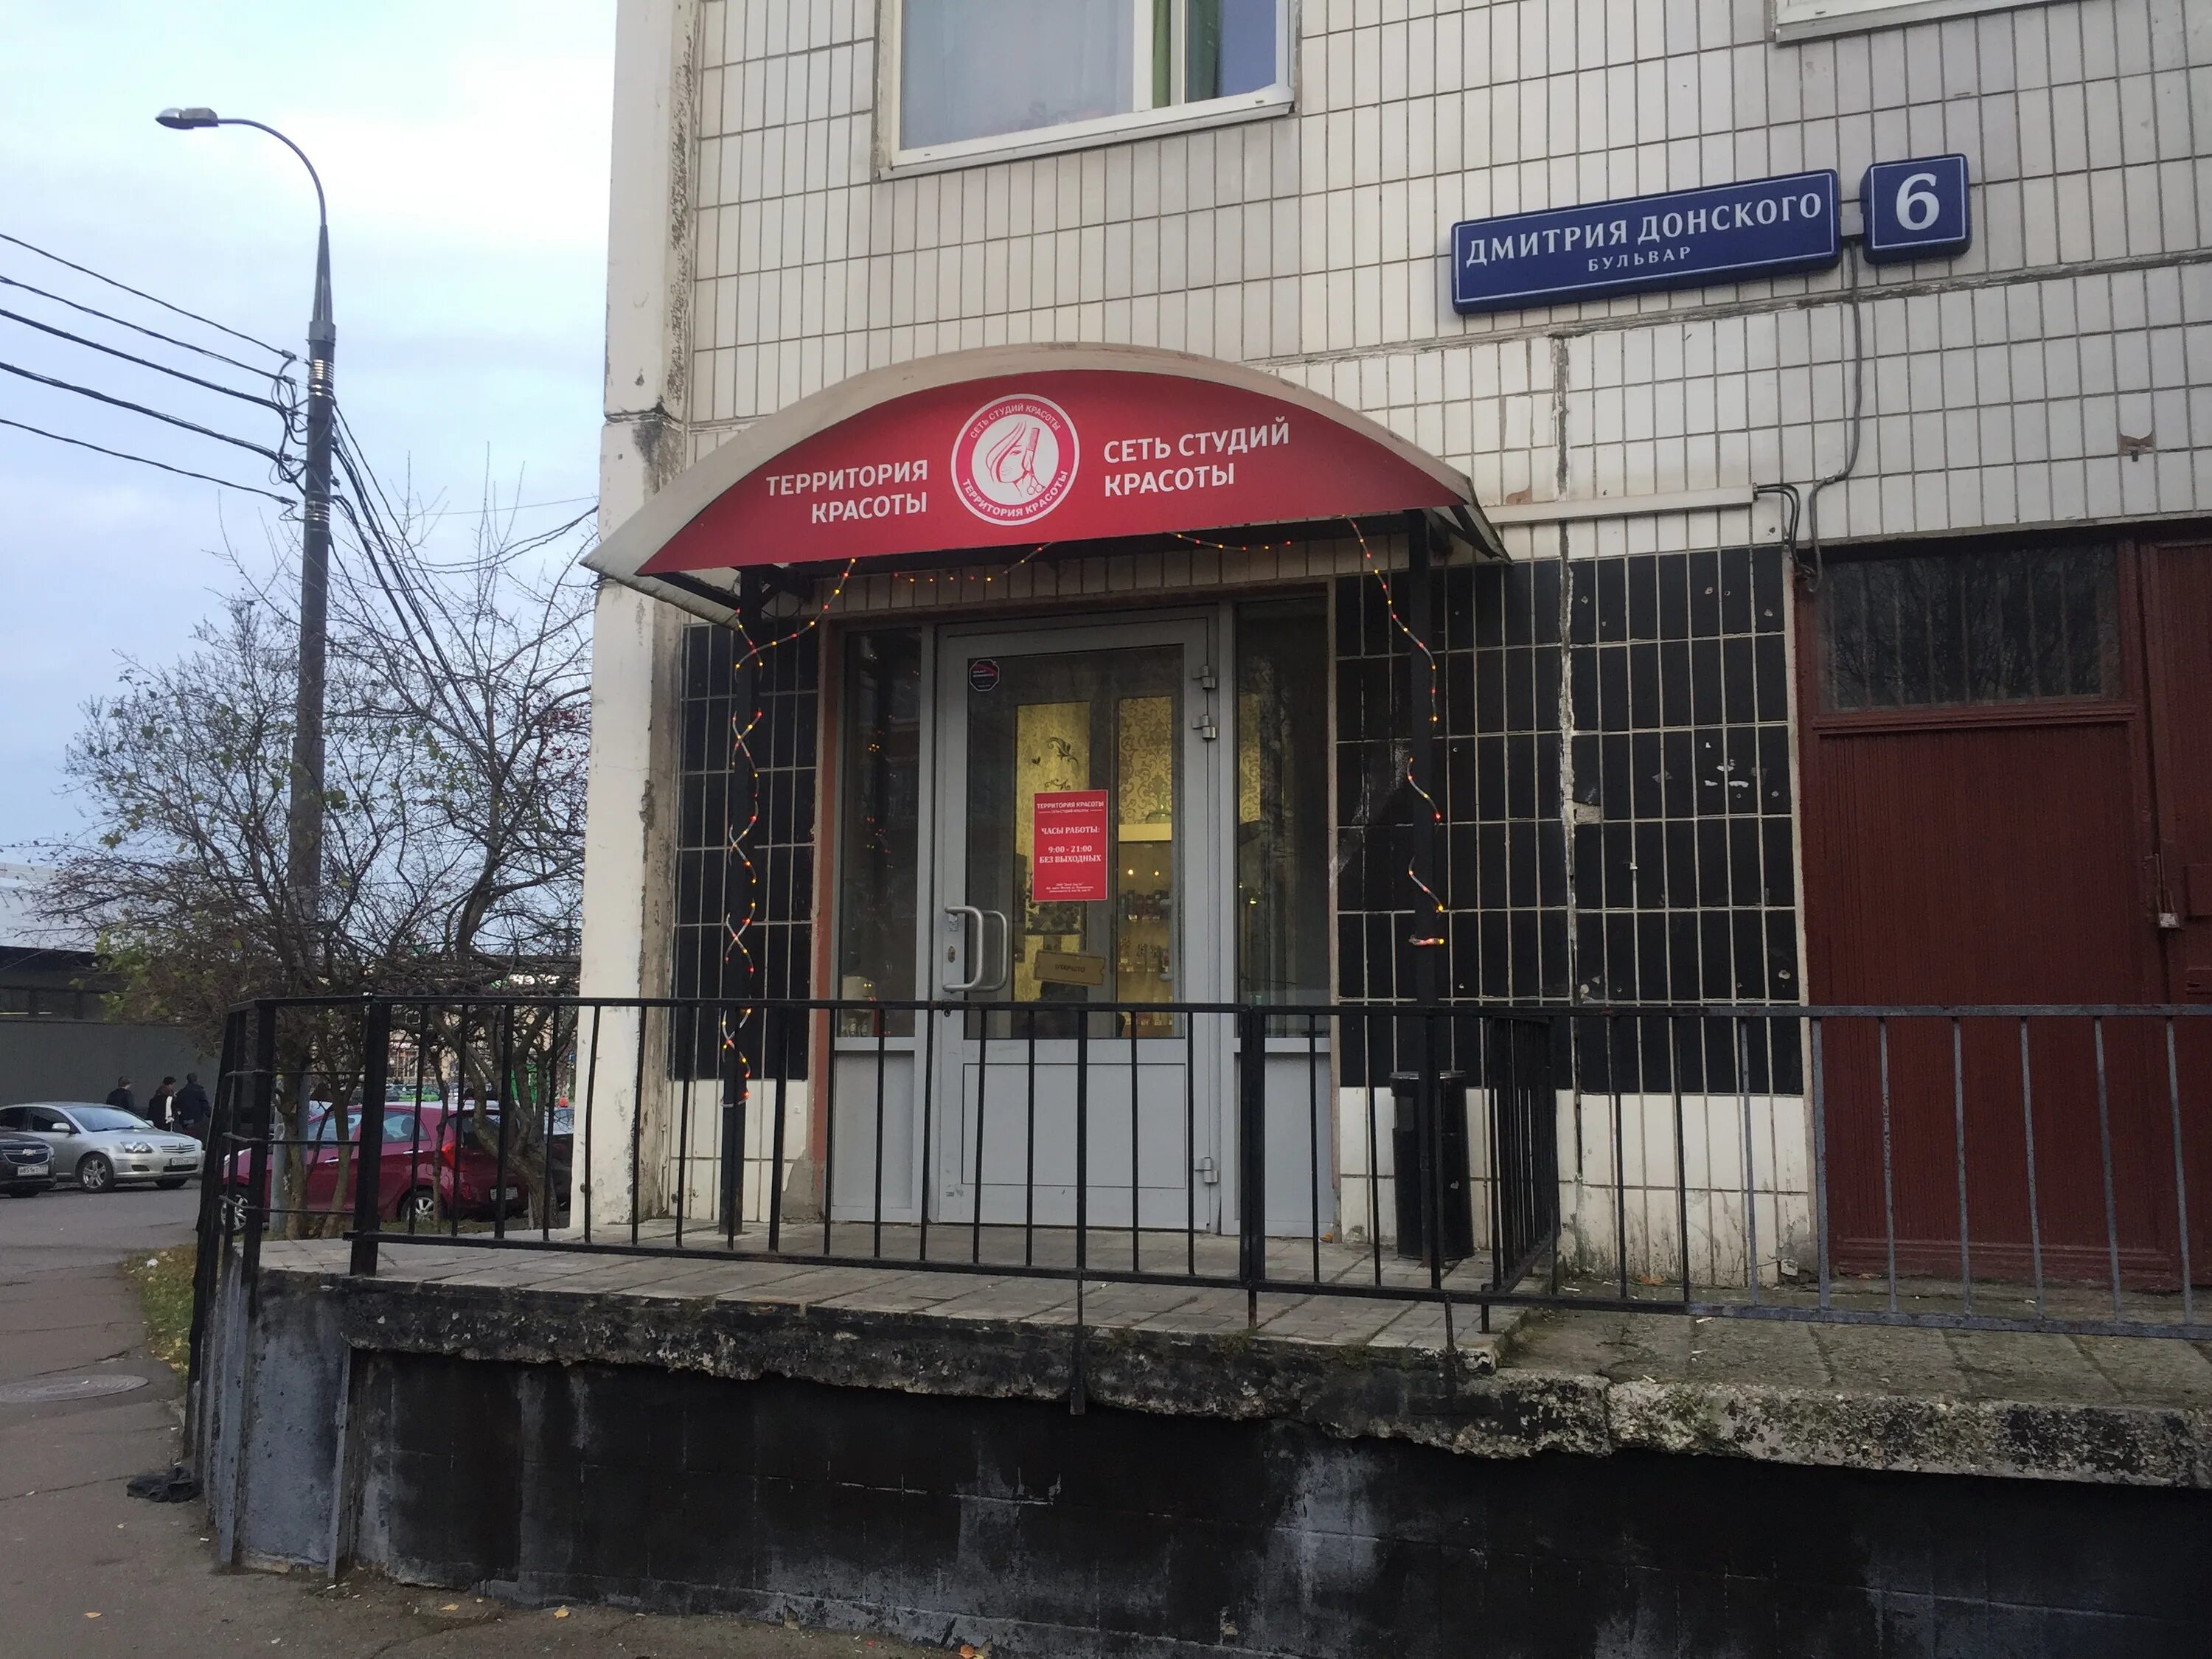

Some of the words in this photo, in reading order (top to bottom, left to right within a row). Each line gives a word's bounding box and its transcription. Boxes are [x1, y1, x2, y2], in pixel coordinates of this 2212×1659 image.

[1895, 173, 1941, 231] 6
[1466, 220, 1627, 267] ДМИТРИЯ
[1638, 192, 1822, 244] ДОНСКОГО
[1587, 246, 1692, 273] БУЛЬВАР
[970, 419, 990, 439] СЕТЬ
[988, 403, 1024, 421] СТУДИЙ
[1026, 405, 1061, 431] КРАСОТЫ
[1104, 438, 1172, 465] СЕТЬ
[1178, 417, 1290, 457] СТУДИЙ
[765, 459, 928, 498] ТЕРРИТОРИЯ
[962, 478, 1023, 517] ТЕРРИТОРИЯ
[1026, 470, 1068, 515] КРАСОТЫ
[1105, 462, 1235, 498] КРАСОТЫ
[811, 493, 928, 524] КРАСОТЫ
[1041, 827, 1064, 835] ЧАСЫ
[1065, 826, 1100, 834] РАБОТЫ:
[1039, 855, 1054, 863] БЕЗ
[1054, 855, 1102, 863] ВЫХОДНЫХ
